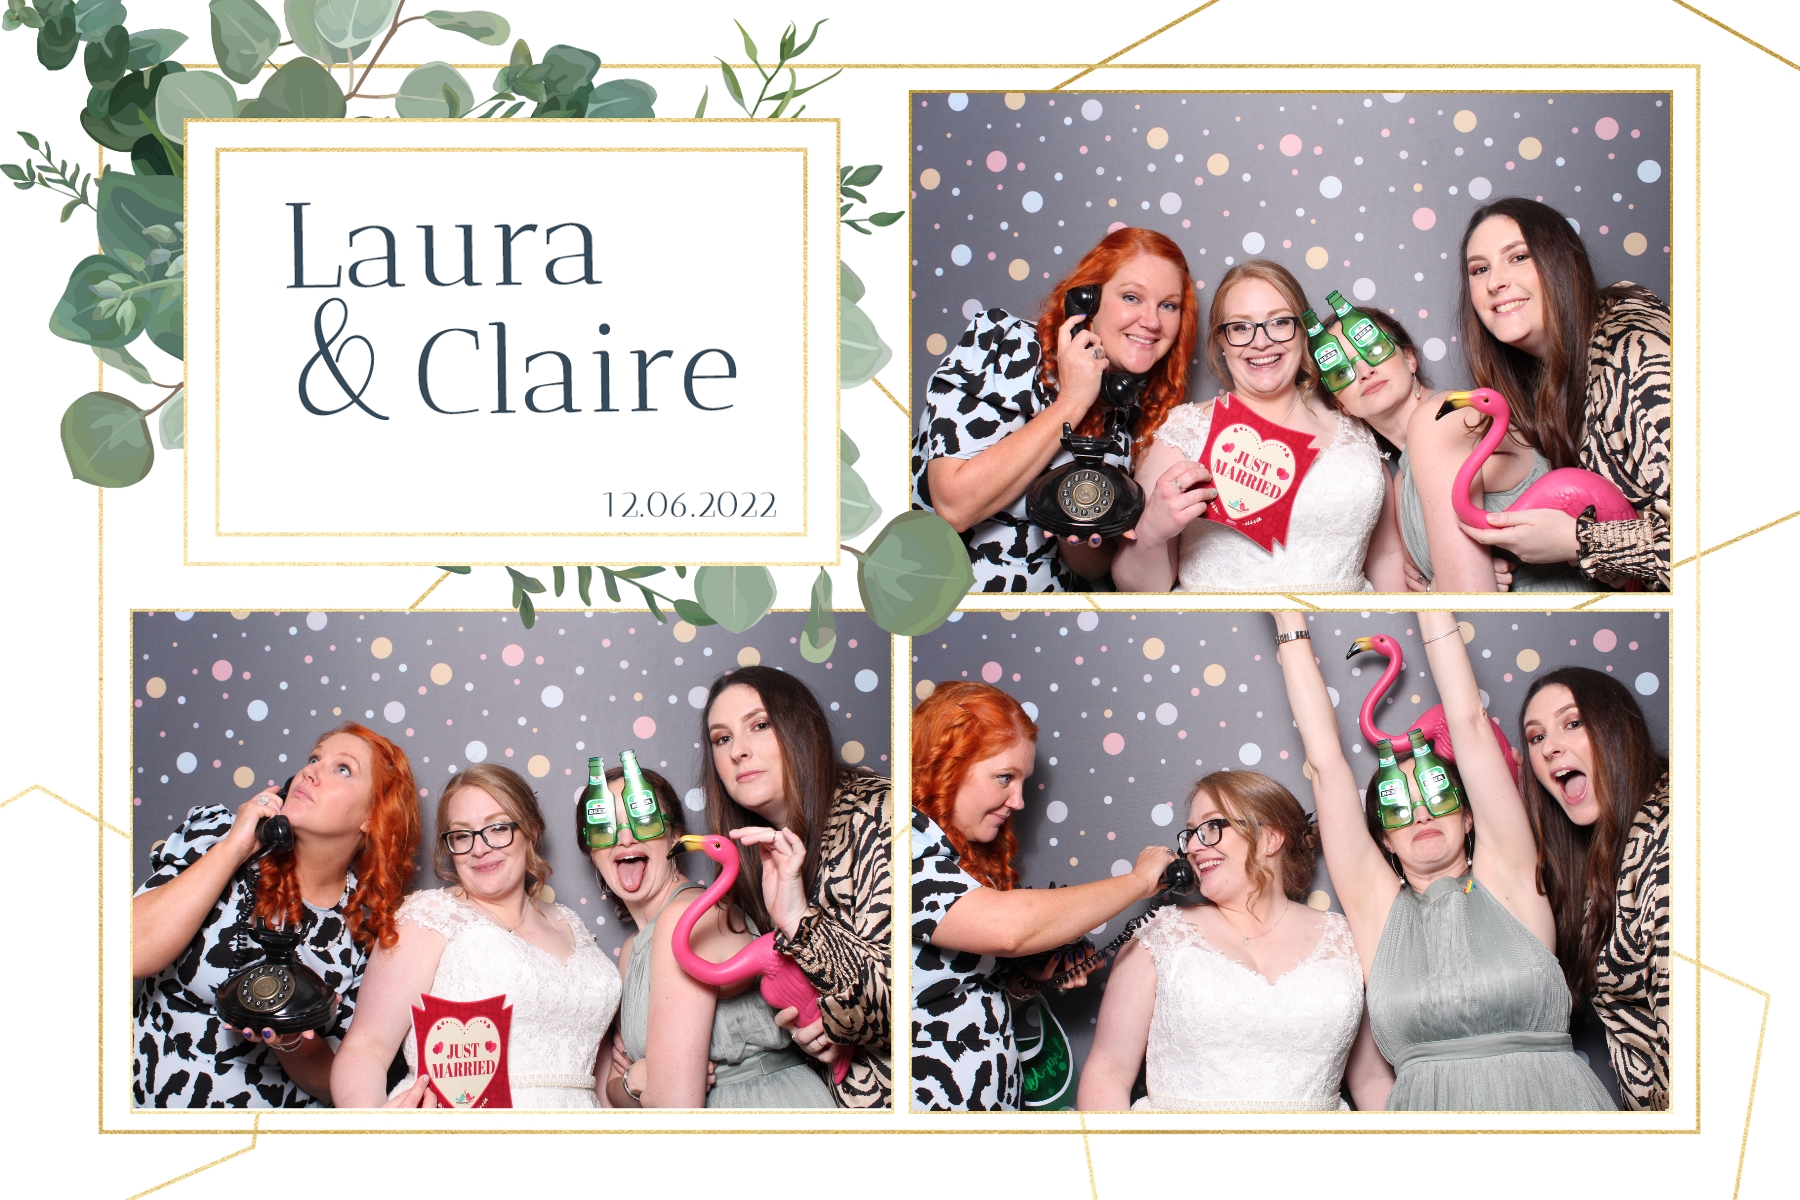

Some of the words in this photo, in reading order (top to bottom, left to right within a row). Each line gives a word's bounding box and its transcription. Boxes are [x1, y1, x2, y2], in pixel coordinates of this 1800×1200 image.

[1234, 450, 1272, 476] JUST
[1212, 458, 1282, 500] MARRIED
[630, 798, 652, 809] BR
[447, 1042, 480, 1060] JUST
[431, 1059, 496, 1079] MARRIED
